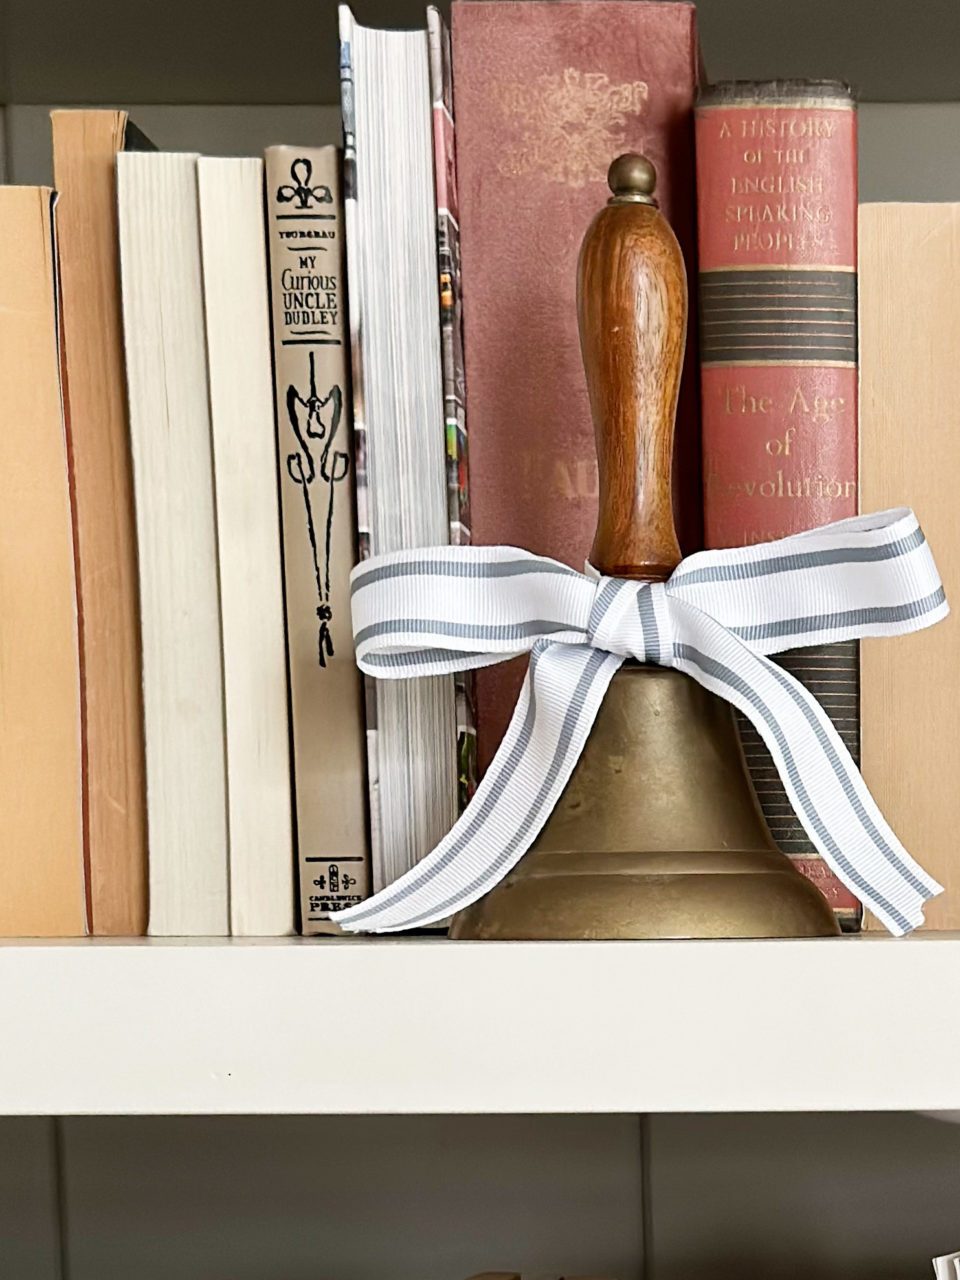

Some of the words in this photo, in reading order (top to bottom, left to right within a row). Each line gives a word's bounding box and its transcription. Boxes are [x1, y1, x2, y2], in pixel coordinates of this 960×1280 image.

[299, 256, 316, 269] MY
[281, 268, 337, 291] Curious
[283, 292, 338, 310] UNCLE
[284, 311, 338, 326] DUDLEY
[790, 386, 845, 425] Age
[766, 427, 797, 456] of
[310, 902, 358, 912] PRES
